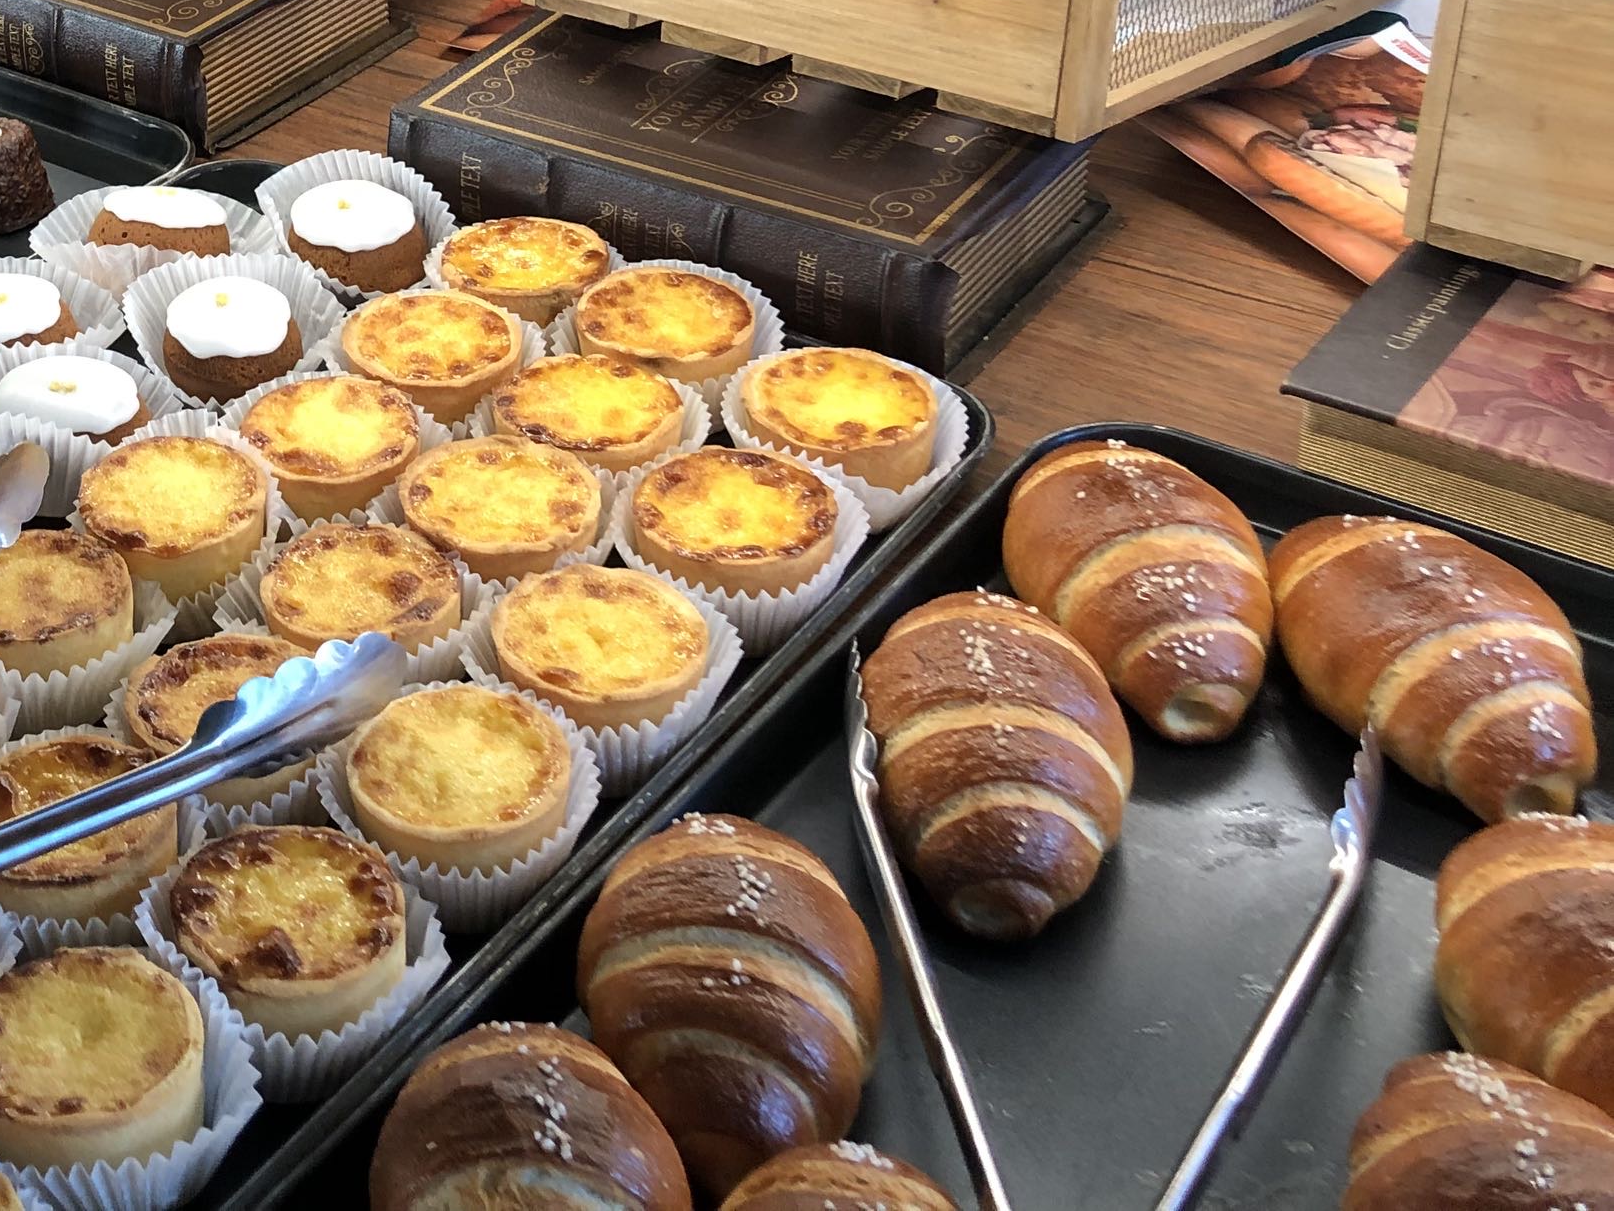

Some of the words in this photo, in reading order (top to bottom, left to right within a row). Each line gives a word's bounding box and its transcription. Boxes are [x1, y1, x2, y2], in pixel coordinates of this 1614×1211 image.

[105, 42, 118, 70] HERE
[122, 55, 135, 82] TEXT
[638, 100, 695, 132] YOUR
[460, 152, 482, 189] TEXT
[796, 250, 819, 285] HERE
[825, 269, 845, 302] TEXT
[1386, 311, 1435, 350] Classic
